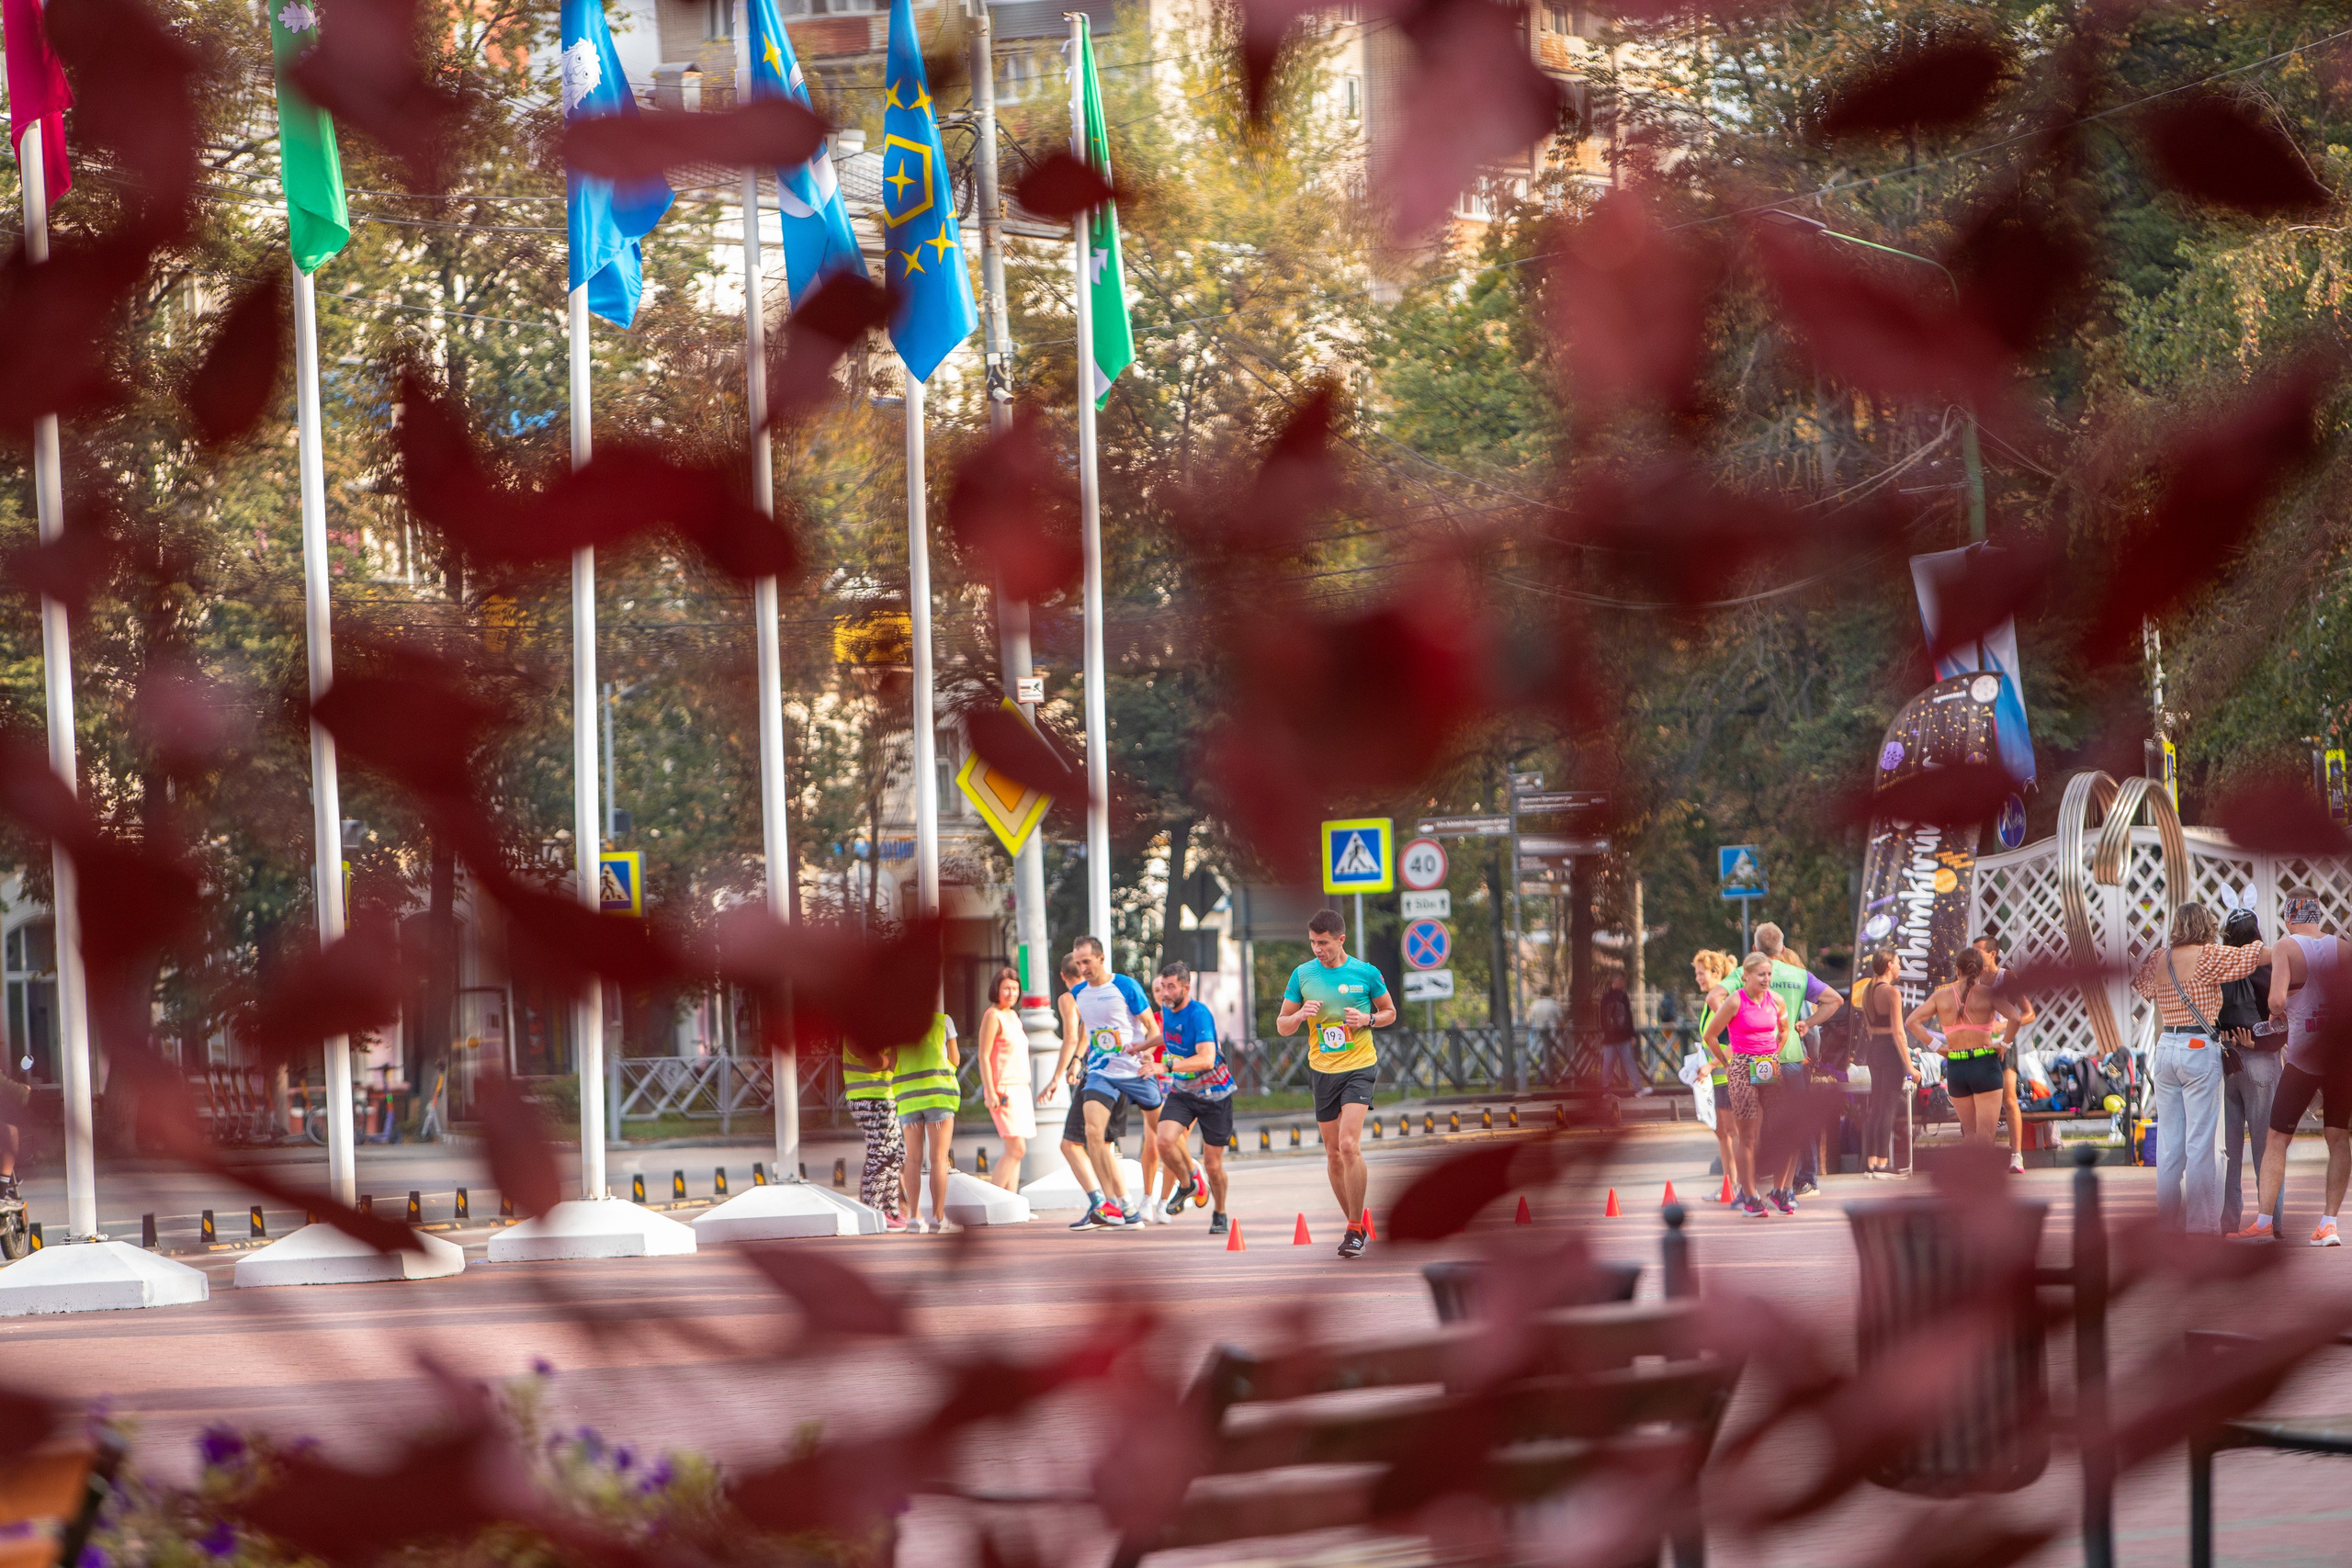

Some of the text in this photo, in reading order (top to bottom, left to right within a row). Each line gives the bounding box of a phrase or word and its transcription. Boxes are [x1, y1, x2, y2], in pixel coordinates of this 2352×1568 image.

[1410, 854, 1436, 872] 40
[1102, 1035, 1107, 1043] 2
[1326, 1031, 1336, 1042] 19
[1758, 1064, 1769, 1074] 23
